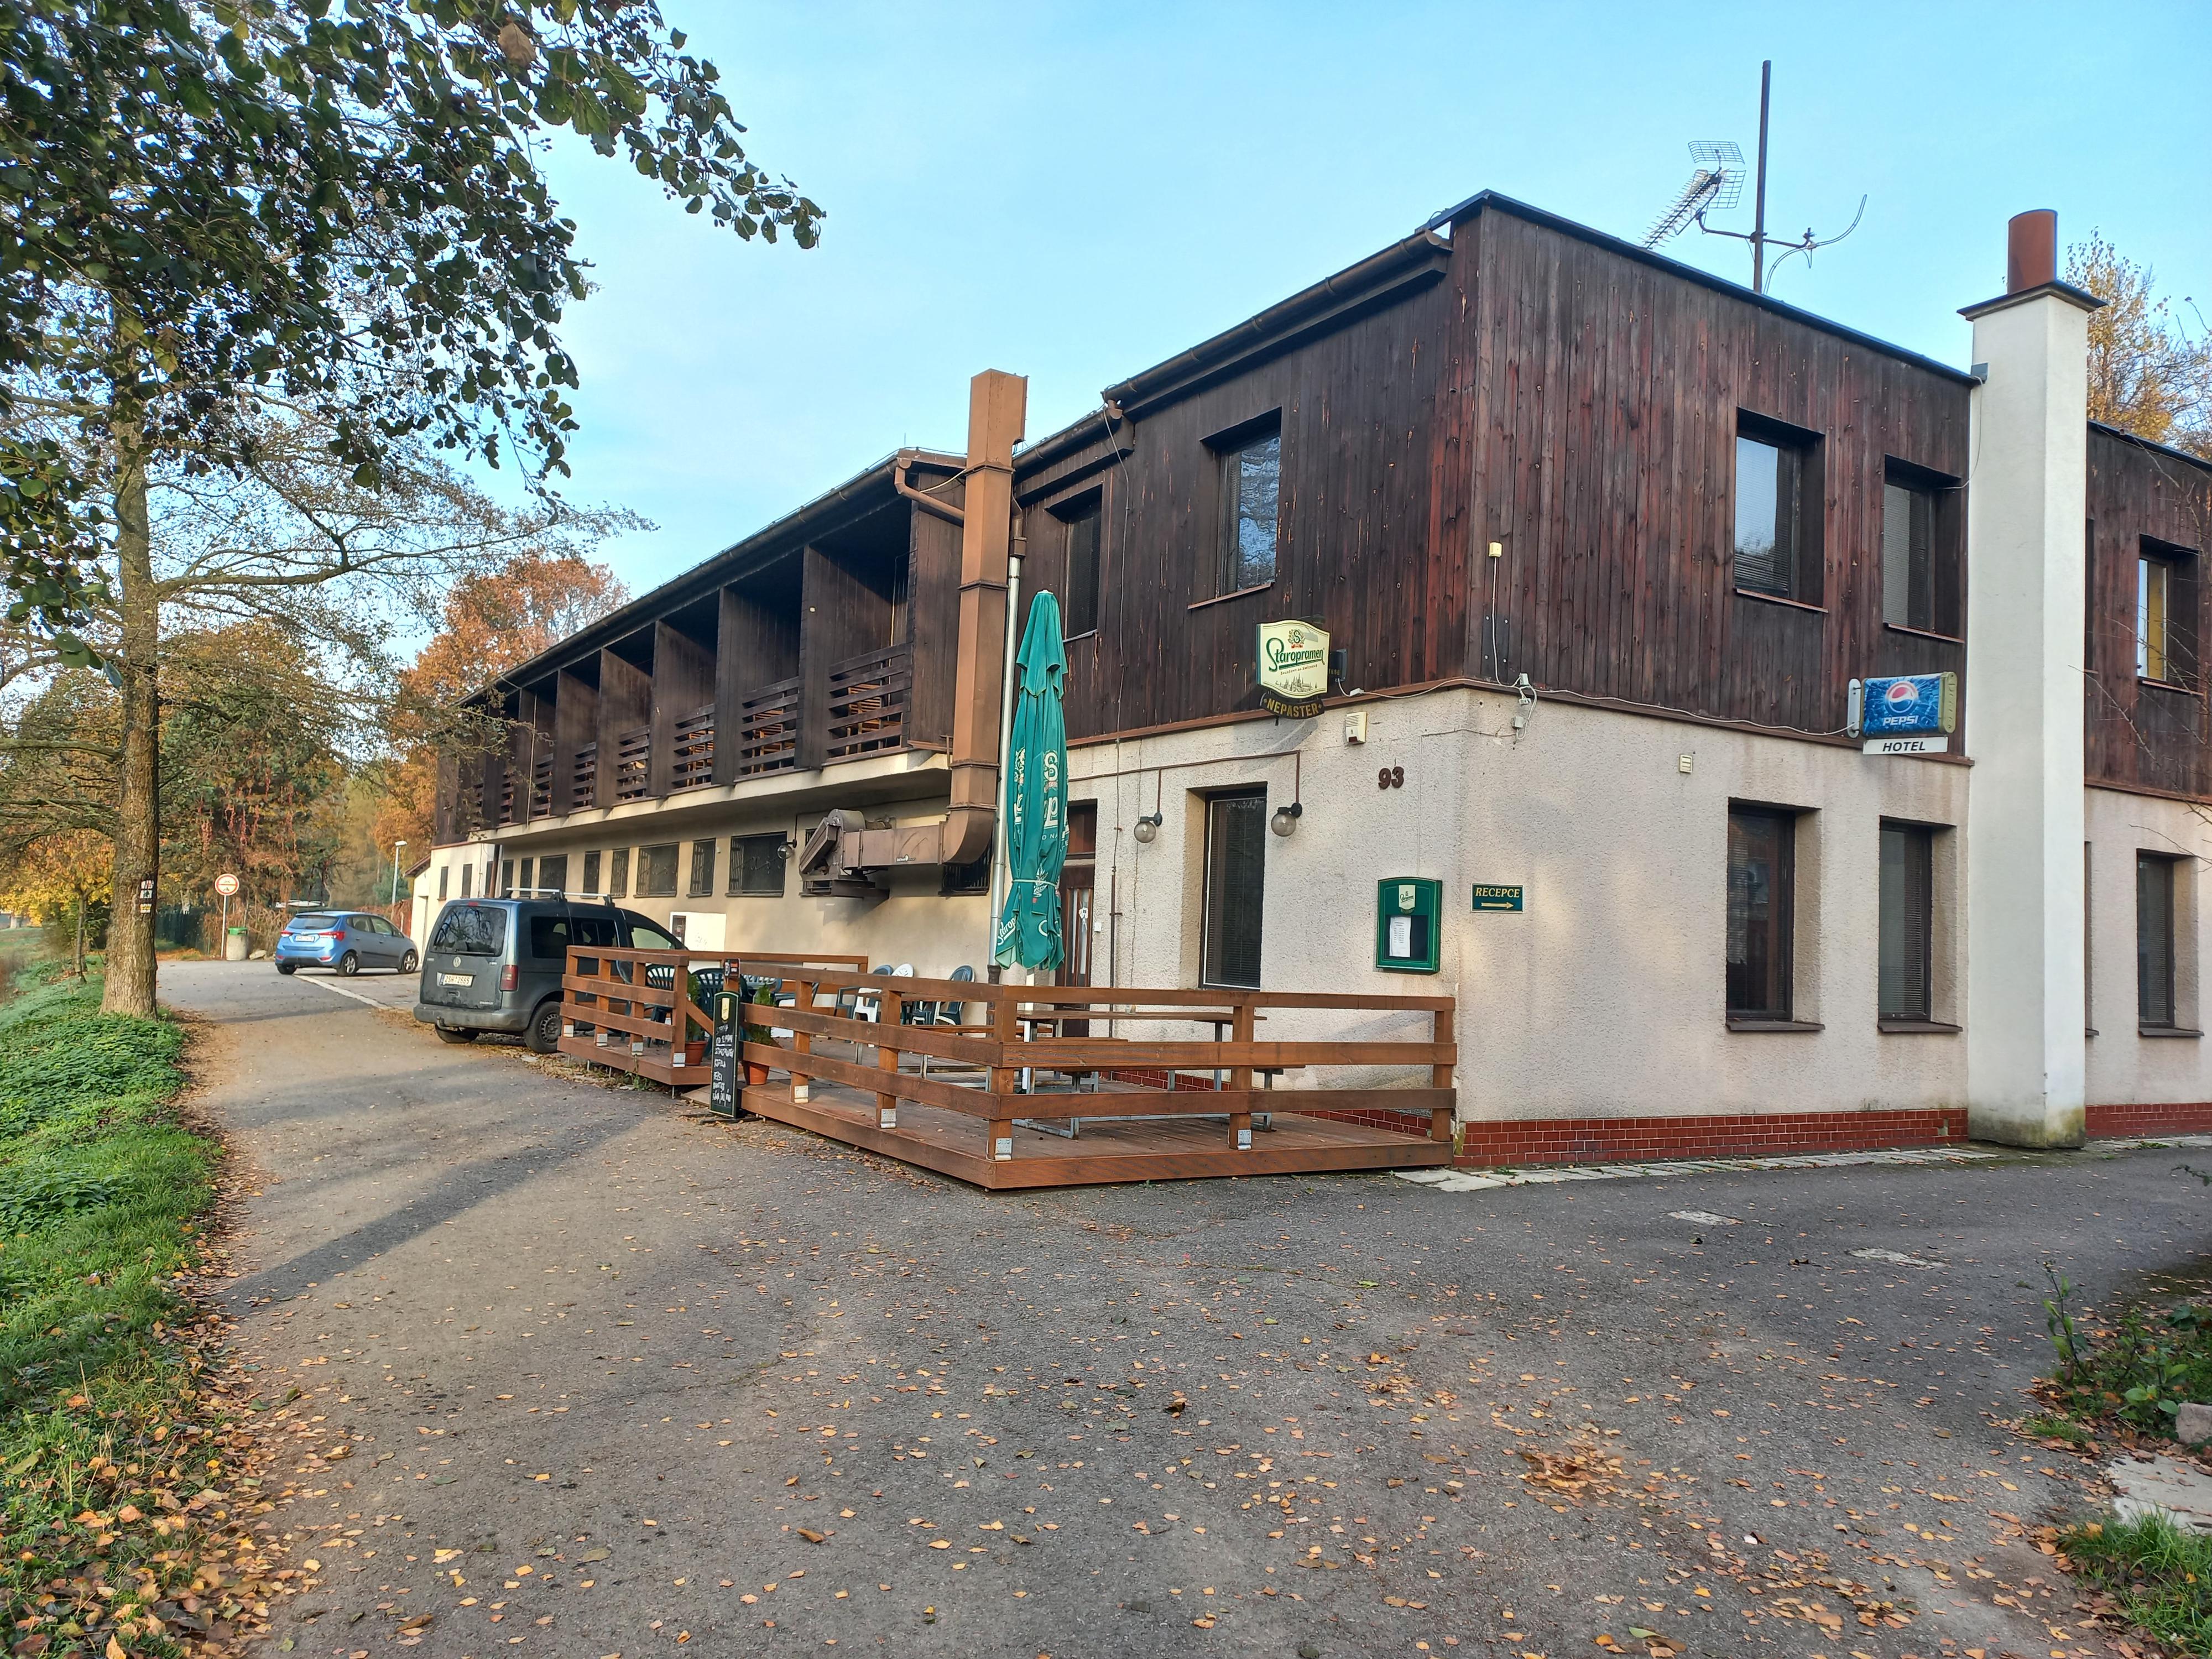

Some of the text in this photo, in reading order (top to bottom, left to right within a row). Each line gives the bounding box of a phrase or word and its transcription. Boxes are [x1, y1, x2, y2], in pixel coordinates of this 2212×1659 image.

[1266, 638, 1325, 672] Staropramen
[1266, 698, 1319, 717] NEPASTER
[1882, 715, 1919, 726] PEPSI
[1882, 742, 1926, 752] HOTEL
[1378, 766, 1405, 790] 93
[1475, 887, 1520, 898] RECEPCE
